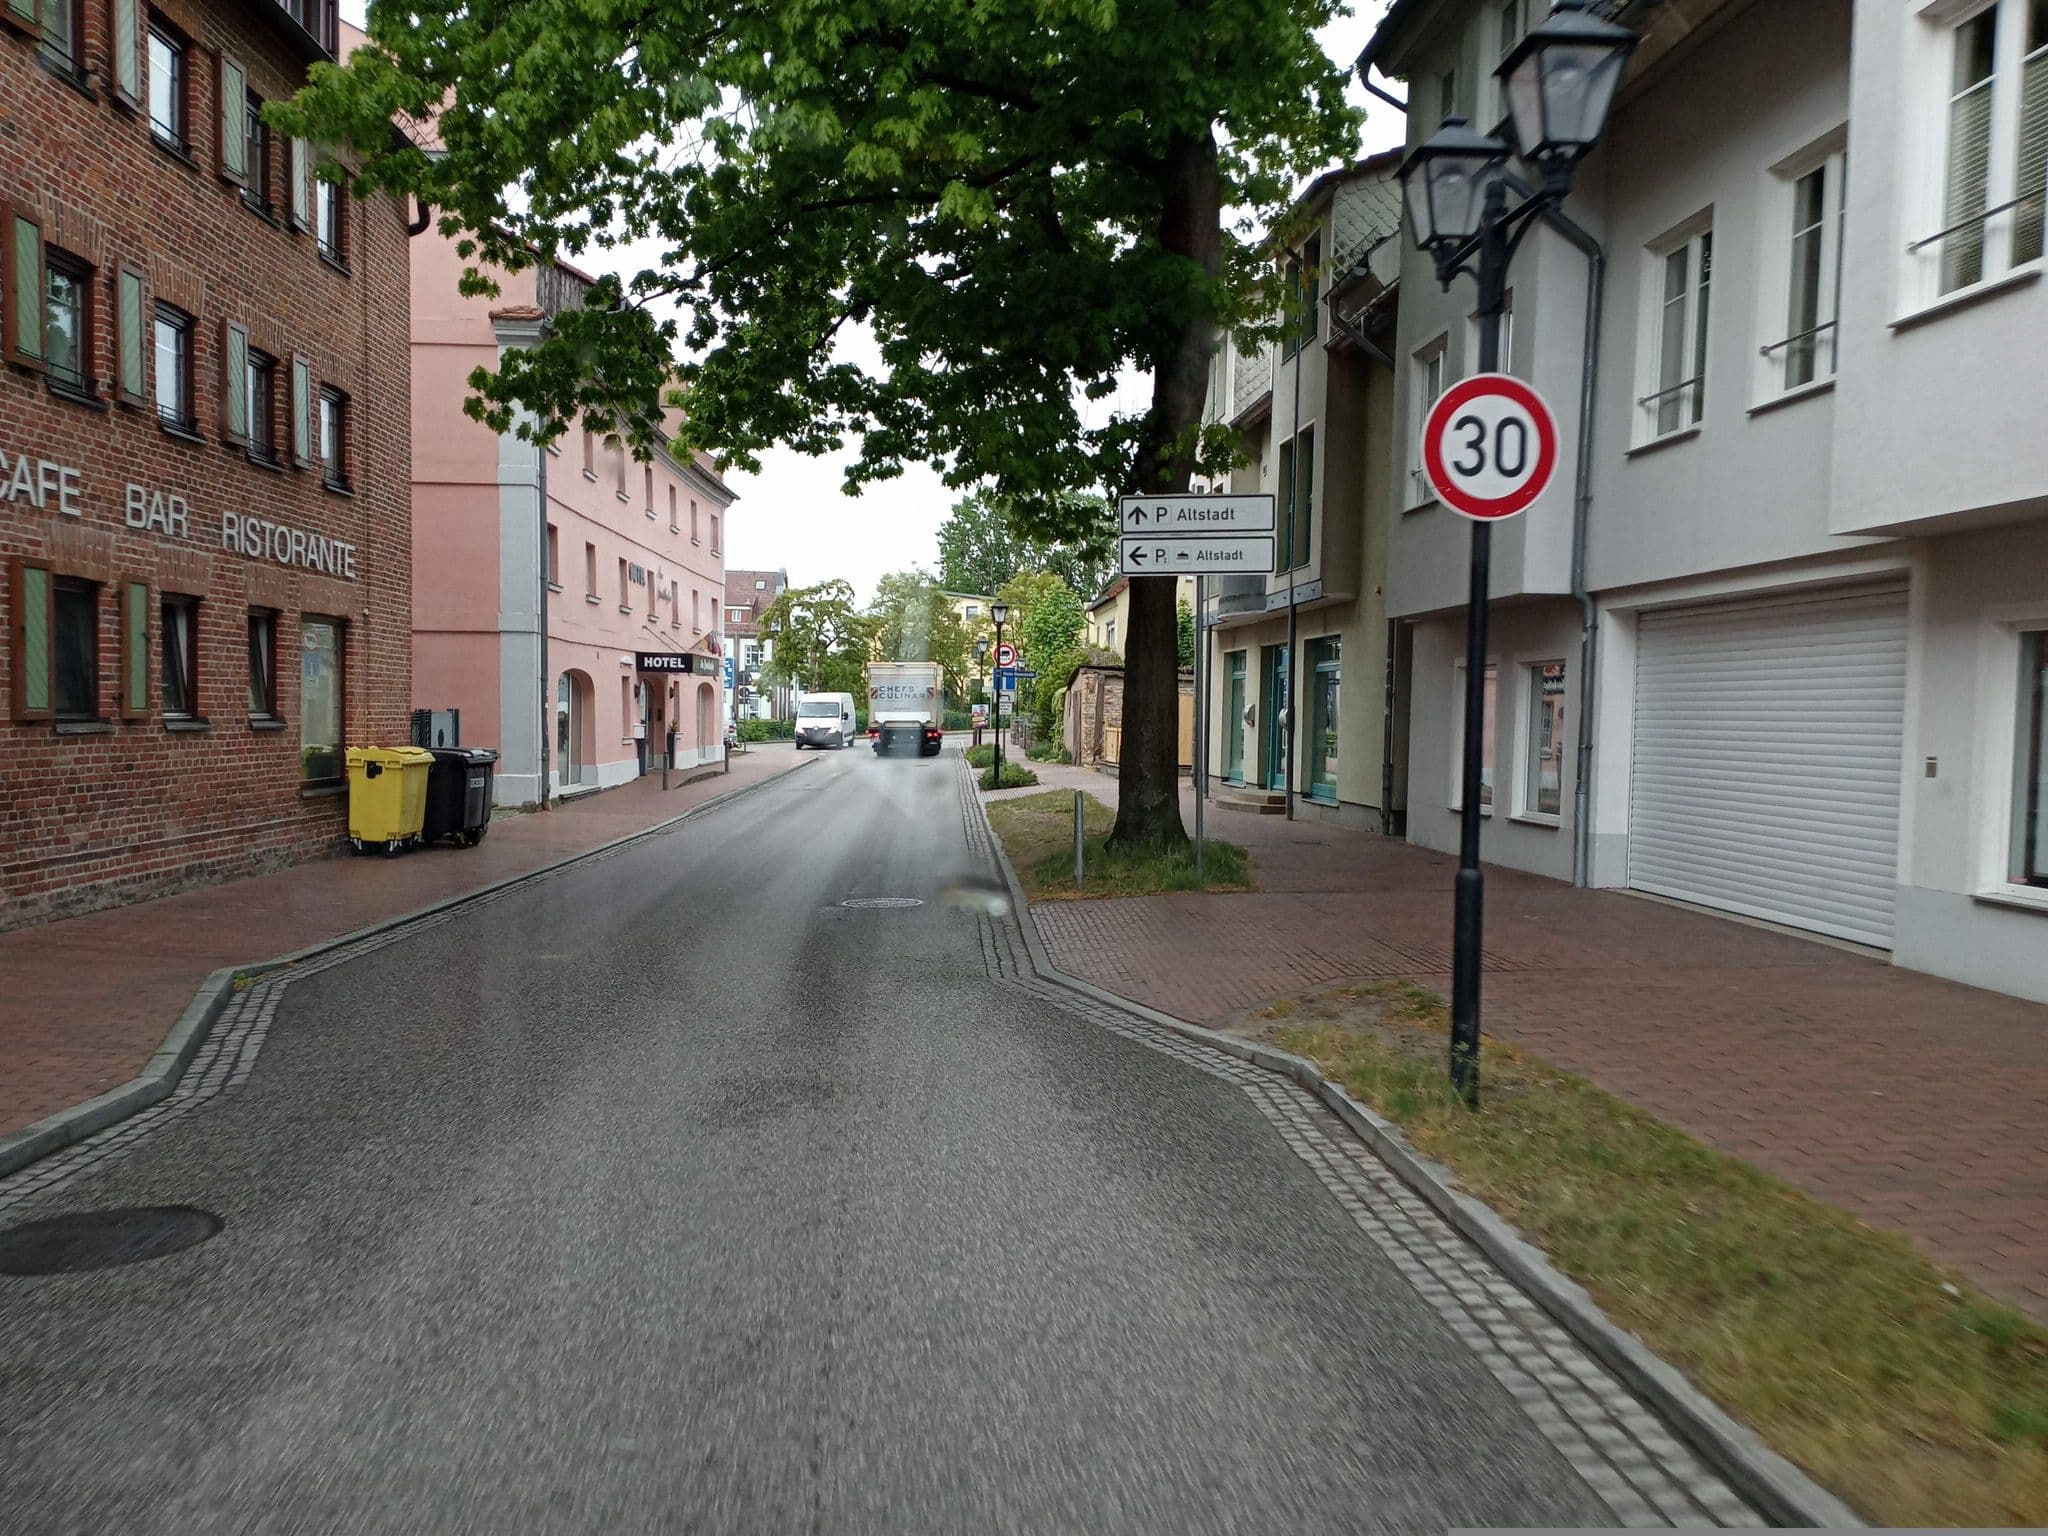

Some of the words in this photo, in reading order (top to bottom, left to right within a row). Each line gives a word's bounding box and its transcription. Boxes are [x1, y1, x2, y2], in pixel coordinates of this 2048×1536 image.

[1452, 414, 1527, 478] 30
[1156, 507, 1168, 523] P
[1177, 508, 1235, 521] Altstadt
[126, 484, 188, 538] BAR
[222, 511, 356, 578] RISTORANTE
[1196, 550, 1243, 561] Altstadt
[643, 656, 685, 668] HOTEL
